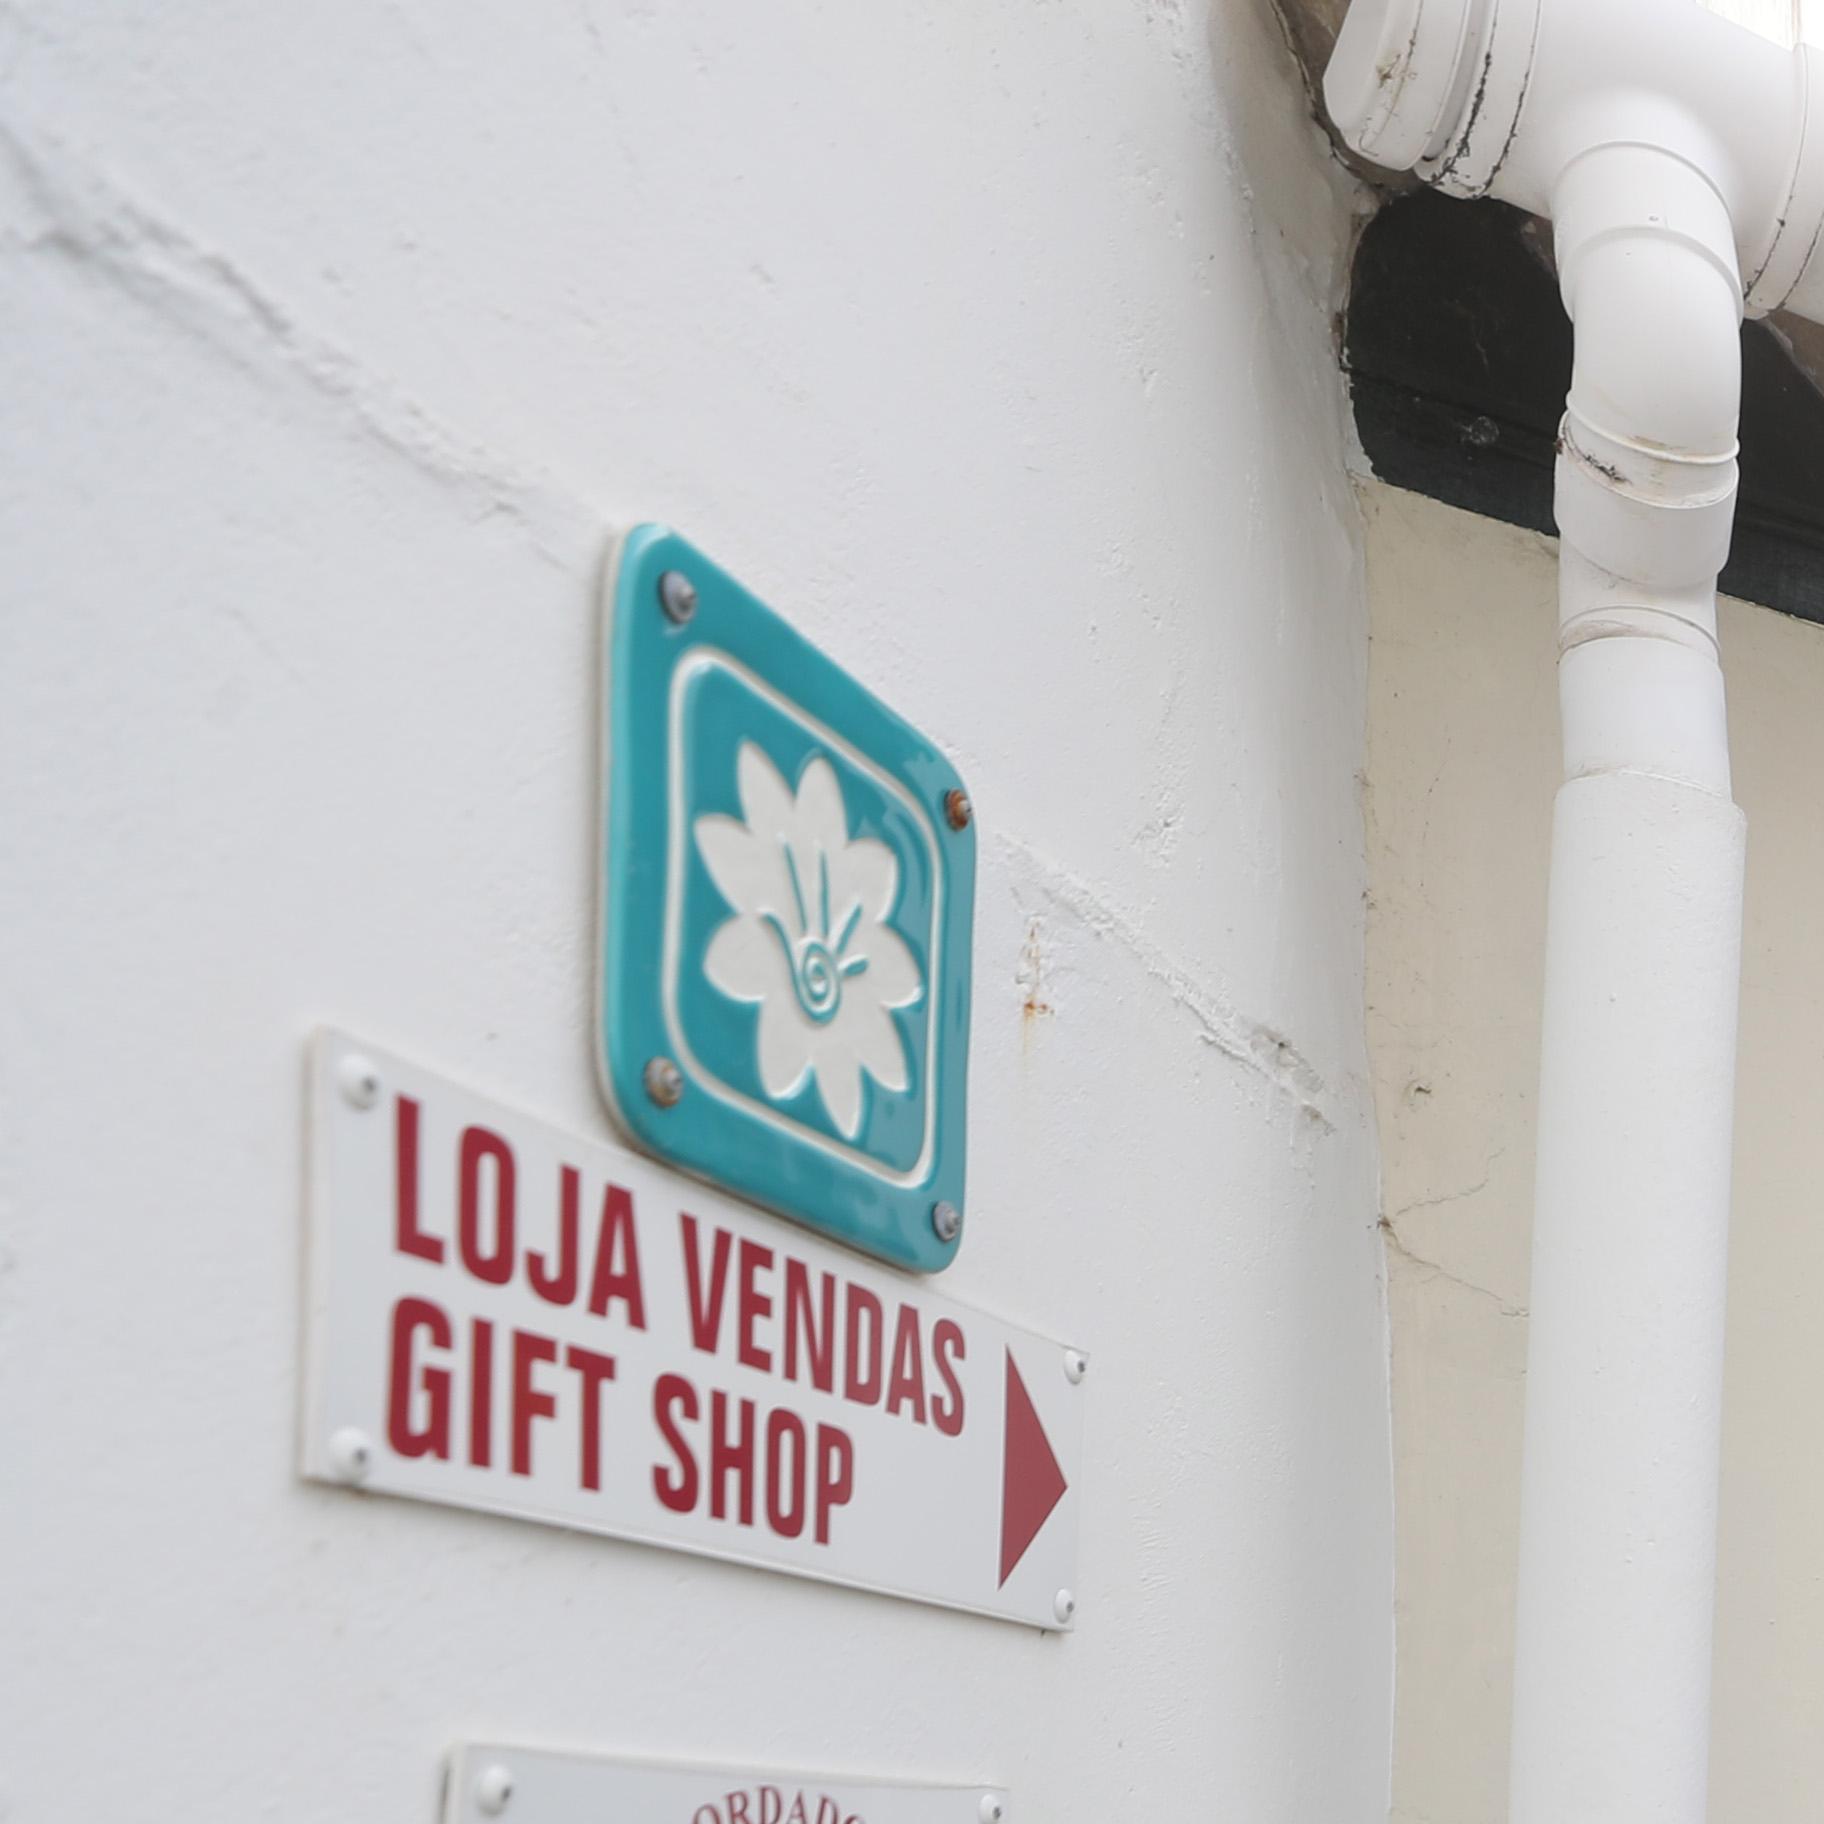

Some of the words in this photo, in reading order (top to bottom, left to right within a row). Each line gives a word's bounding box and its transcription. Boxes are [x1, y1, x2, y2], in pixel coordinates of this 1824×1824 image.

[395, 1094, 648, 1332] LOJA
[678, 1211, 967, 1438] VENDAS
[385, 1295, 618, 1493] GIFT
[652, 1372, 855, 1546] SHOP
